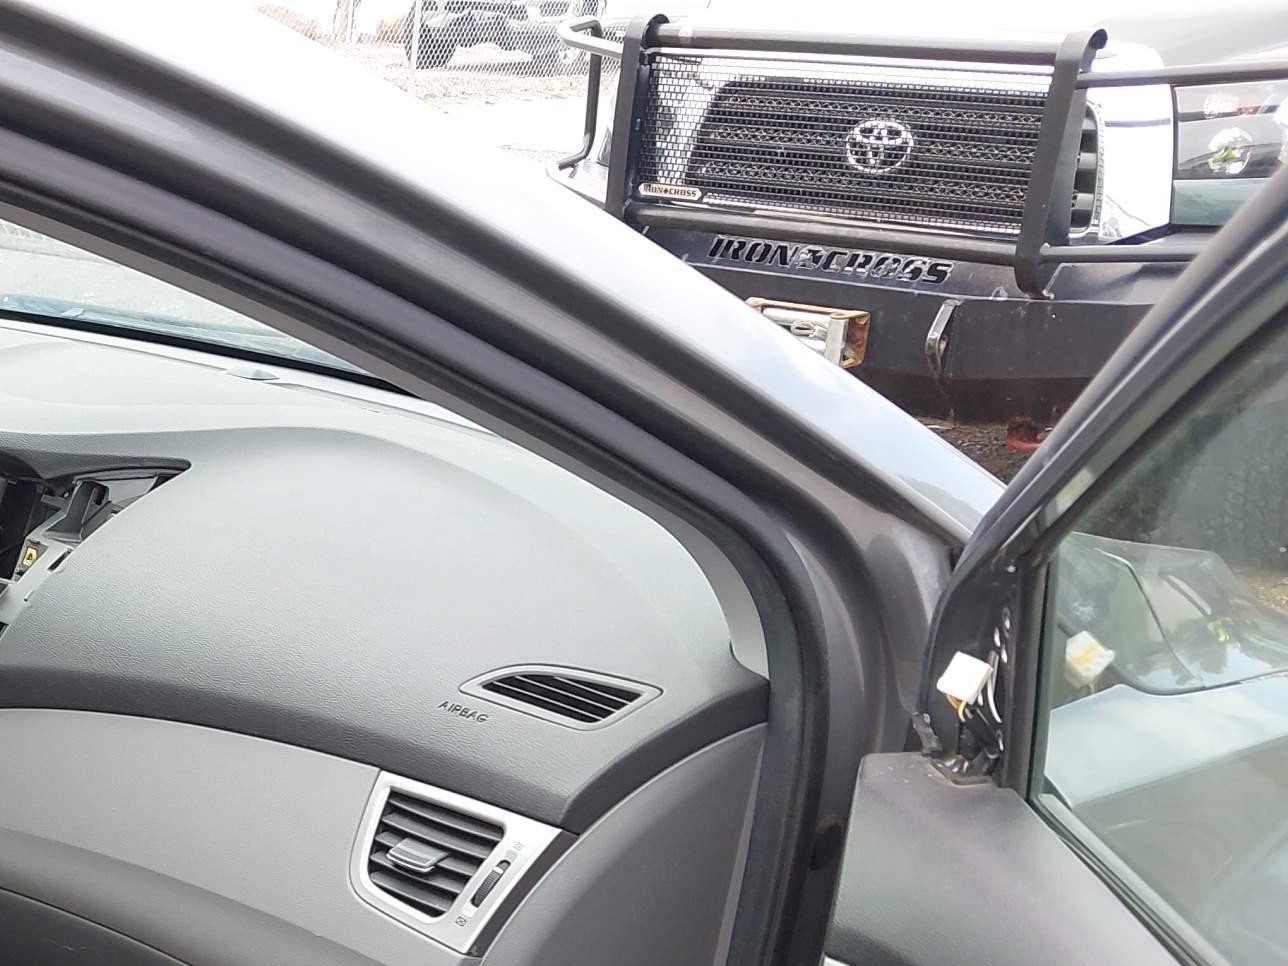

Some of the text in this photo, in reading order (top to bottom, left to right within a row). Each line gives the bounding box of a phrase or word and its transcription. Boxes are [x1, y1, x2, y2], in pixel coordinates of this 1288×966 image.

[708, 235, 954, 284] IRON CROSS
[437, 700, 489, 723] AIRBAG
